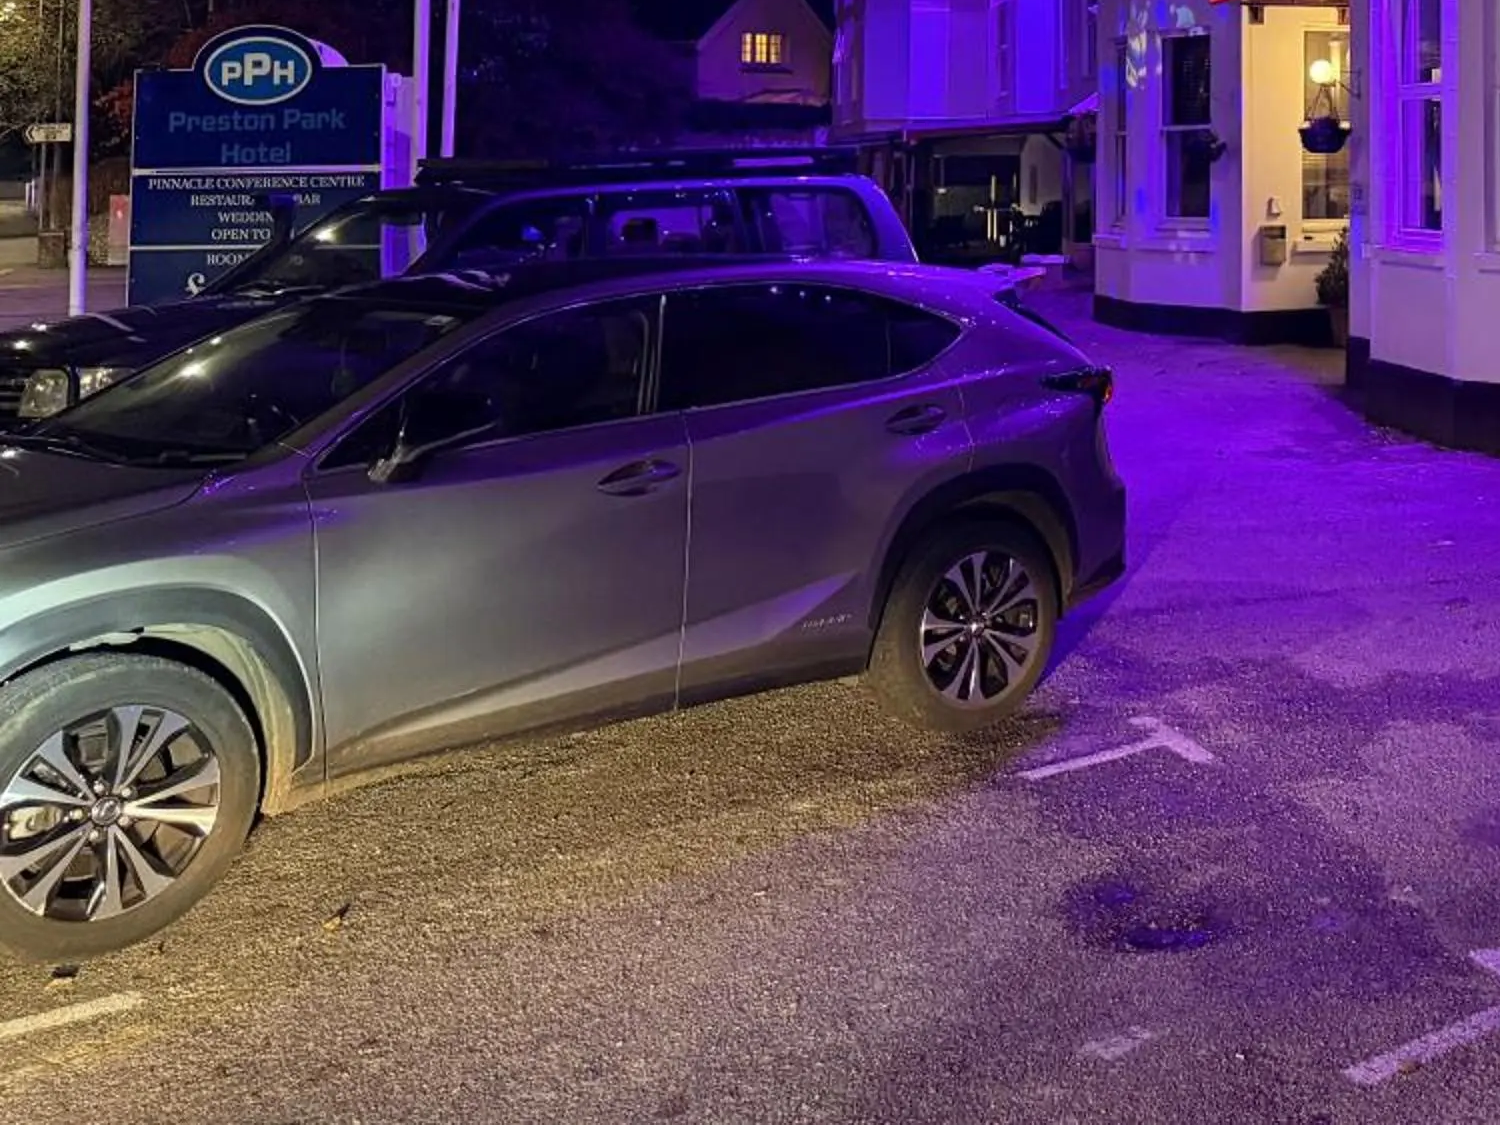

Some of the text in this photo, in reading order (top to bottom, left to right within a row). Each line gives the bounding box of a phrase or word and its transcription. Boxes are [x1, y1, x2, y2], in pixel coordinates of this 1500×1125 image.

[169, 108, 346, 133] Preston Park
[221, 142, 292, 164] Hotel
[148, 176, 365, 191] PINNACLE CONFERENCE CENTRE
[211, 227, 272, 240] OPEN TO
